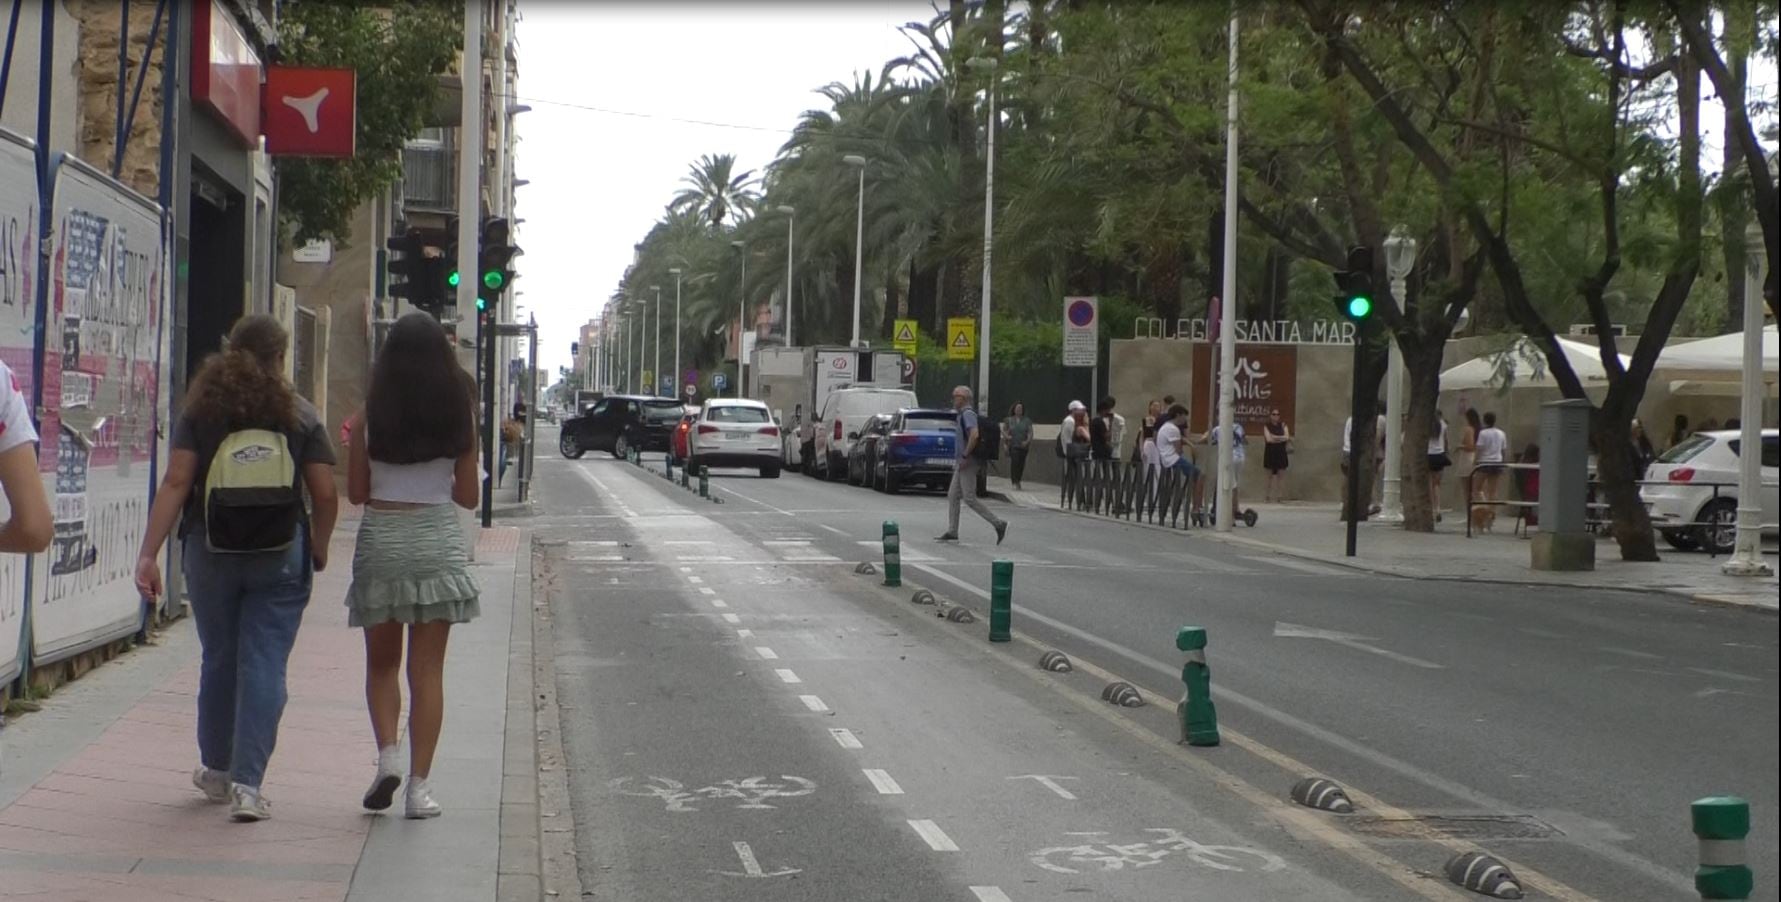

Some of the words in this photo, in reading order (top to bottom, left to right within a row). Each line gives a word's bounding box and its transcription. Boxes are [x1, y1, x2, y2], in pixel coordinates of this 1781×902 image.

[1135, 316, 1222, 342] COLEGI
[1234, 319, 1302, 344] SANTA
[1312, 319, 1360, 345] MAR
[713, 374, 724, 387] P
